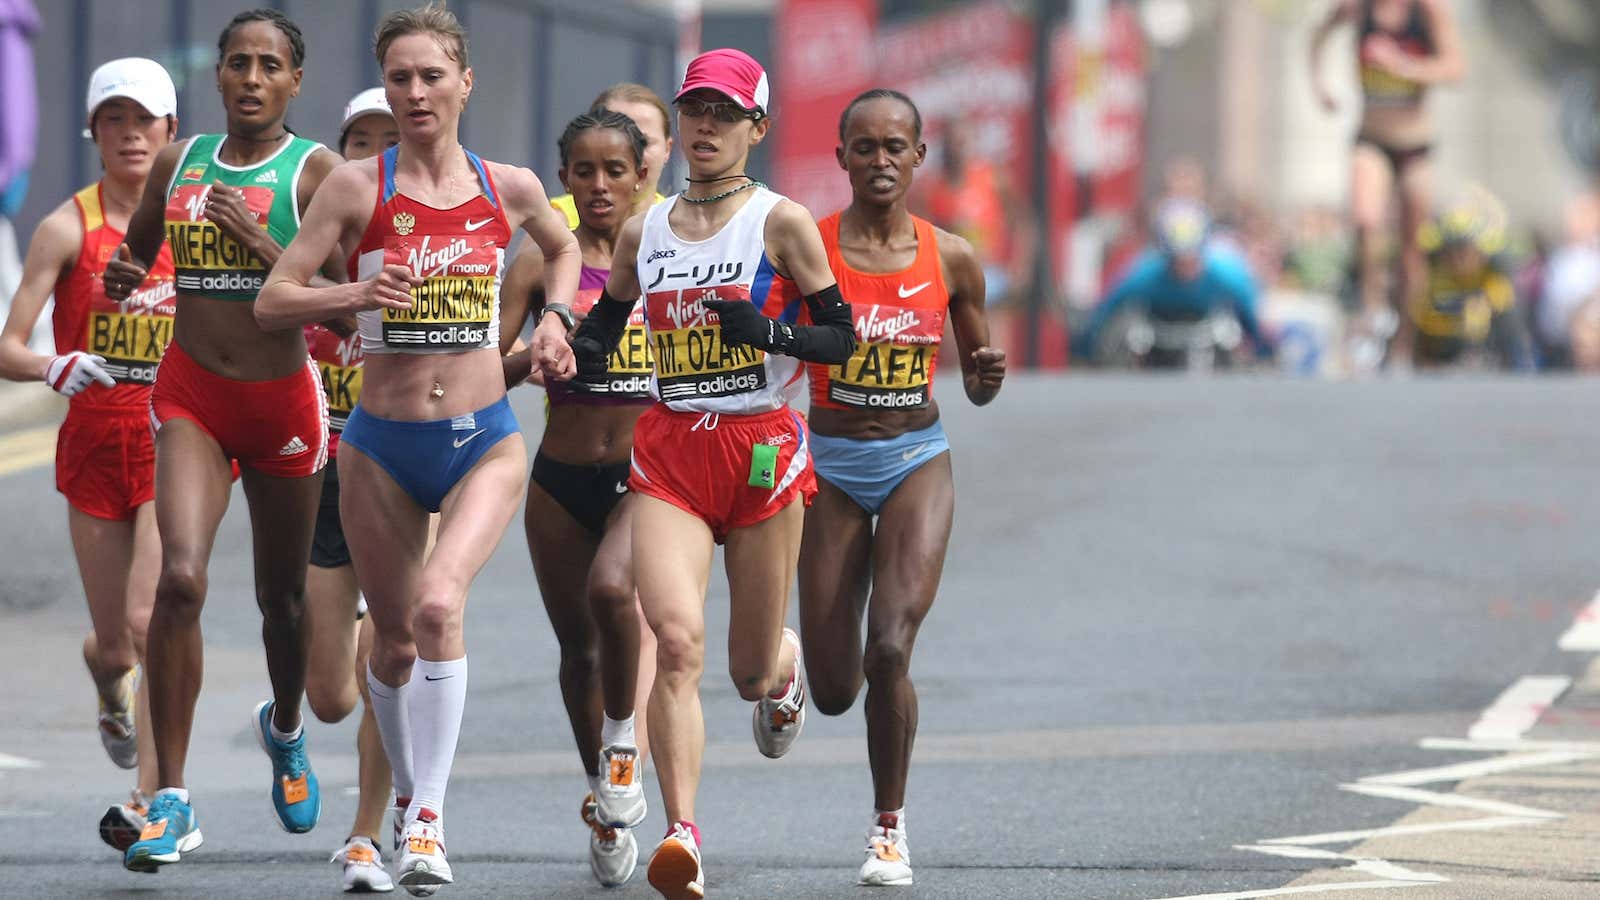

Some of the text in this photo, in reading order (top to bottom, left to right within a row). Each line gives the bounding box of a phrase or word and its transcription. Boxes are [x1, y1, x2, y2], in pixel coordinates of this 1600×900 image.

[407, 235, 473, 278] Virgin
[647, 249, 677, 264] asics
[452, 263, 491, 274] money
[648, 262, 743, 289] ノーリツ
[202, 274, 263, 290] adidas
[666, 287, 723, 329] Virgin
[855, 304, 920, 344] Virgin
[94, 315, 138, 356] BAI
[428, 327, 483, 344] adidas
[657, 333, 683, 374] M.
[610, 377, 650, 392] adid
[699, 373, 759, 394] adidas
[868, 391, 922, 407] adidas
